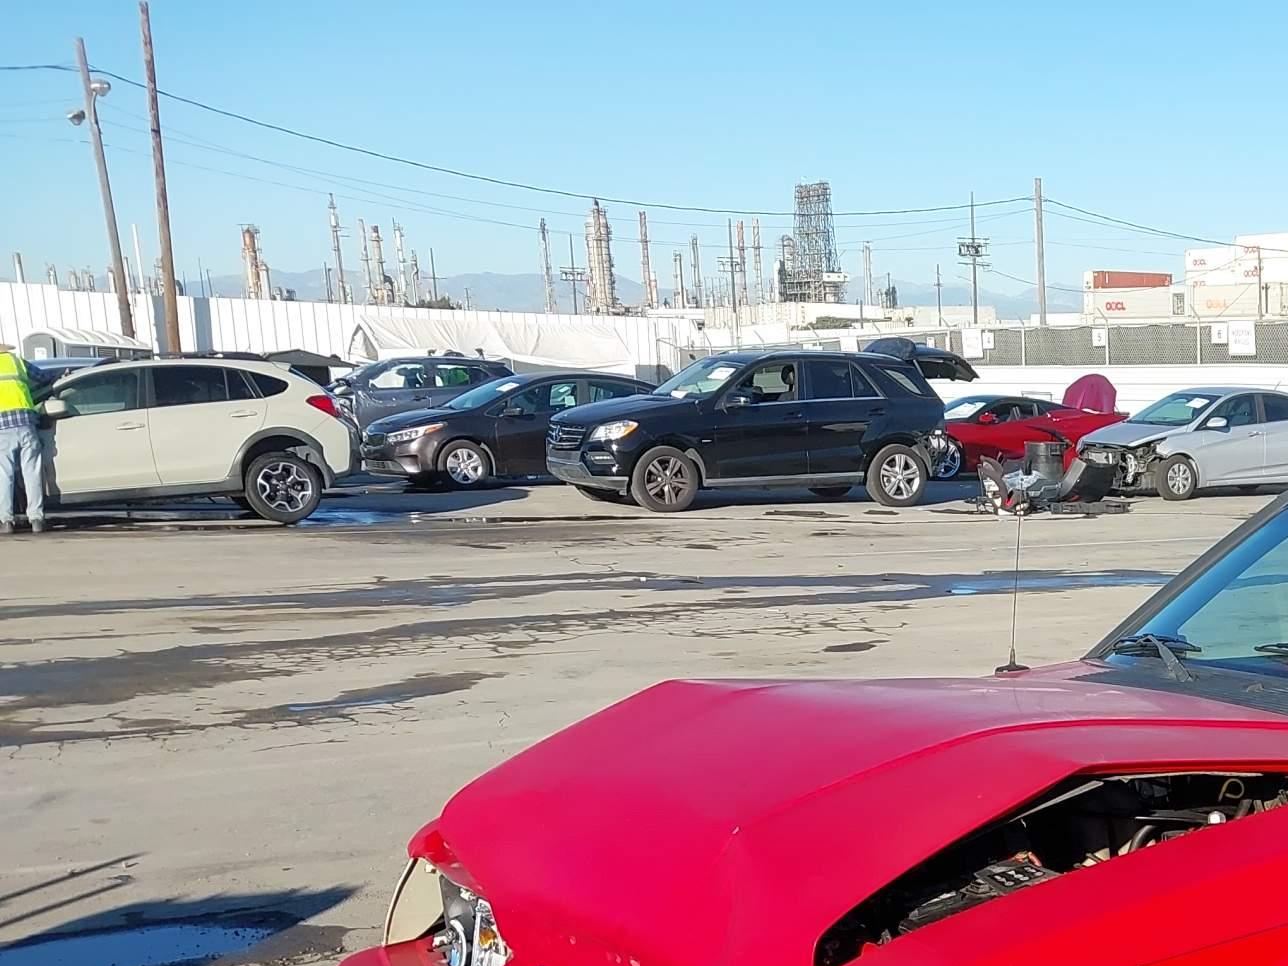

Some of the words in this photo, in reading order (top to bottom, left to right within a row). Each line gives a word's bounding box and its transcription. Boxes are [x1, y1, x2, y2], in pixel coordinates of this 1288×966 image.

[1105, 301, 1126, 311] OOCL
[1097, 333, 1102, 342] 5
[1217, 329, 1222, 339] 6
